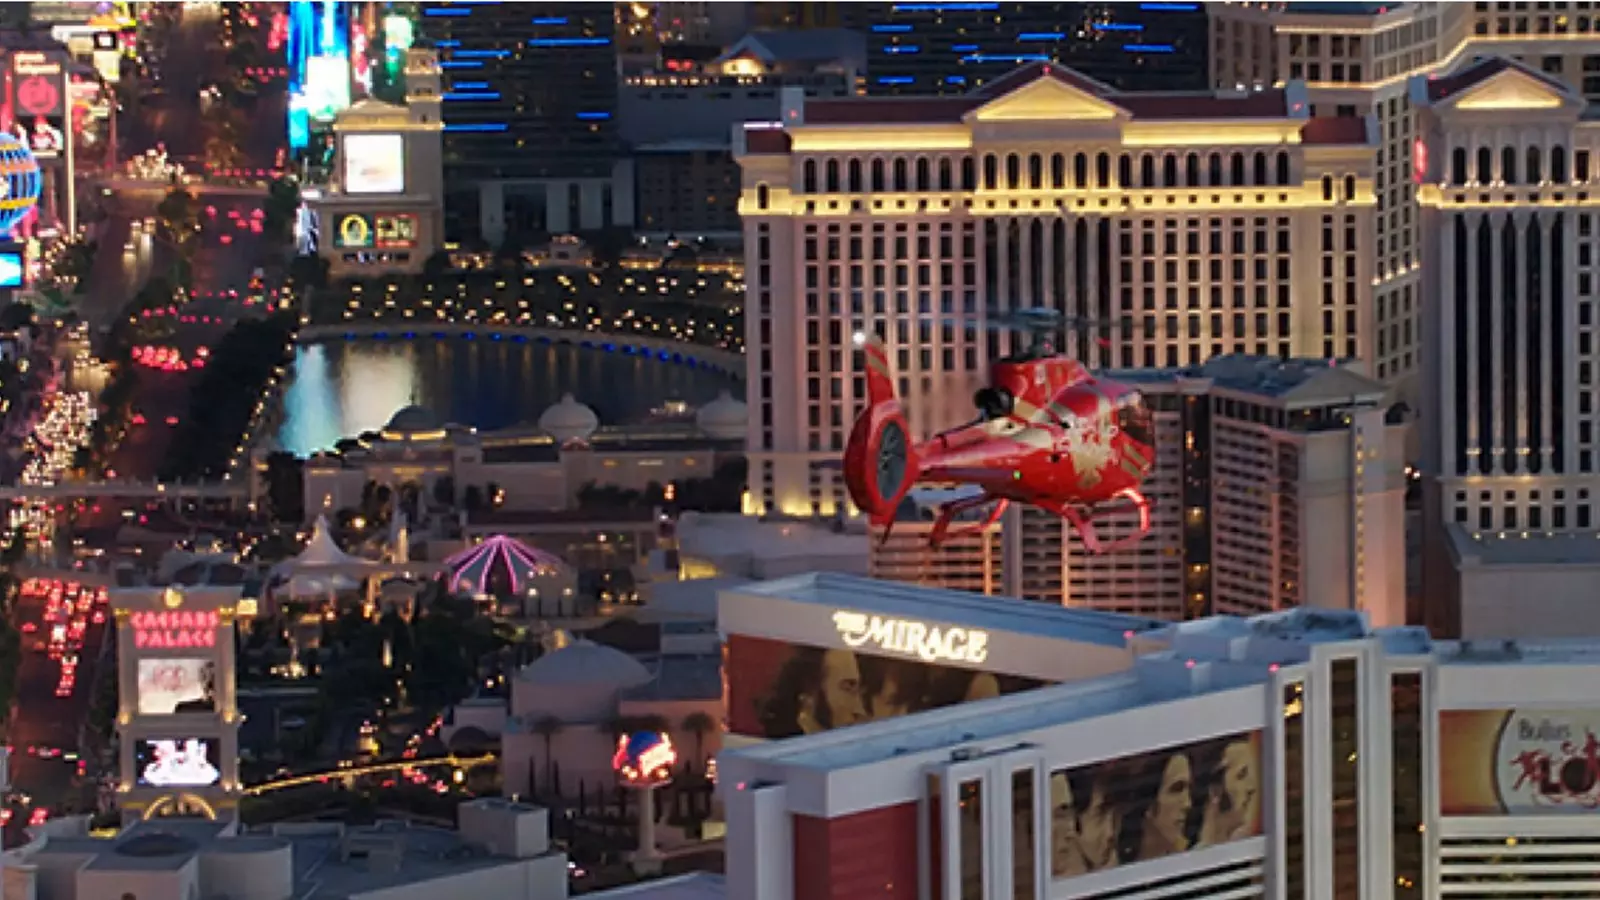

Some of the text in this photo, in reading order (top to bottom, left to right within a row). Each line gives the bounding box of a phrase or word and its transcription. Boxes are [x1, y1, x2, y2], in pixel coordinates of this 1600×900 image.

[131, 610, 218, 629] CAESARS
[135, 629, 216, 648] PALACE
[842, 615, 988, 663] MIRAGE
